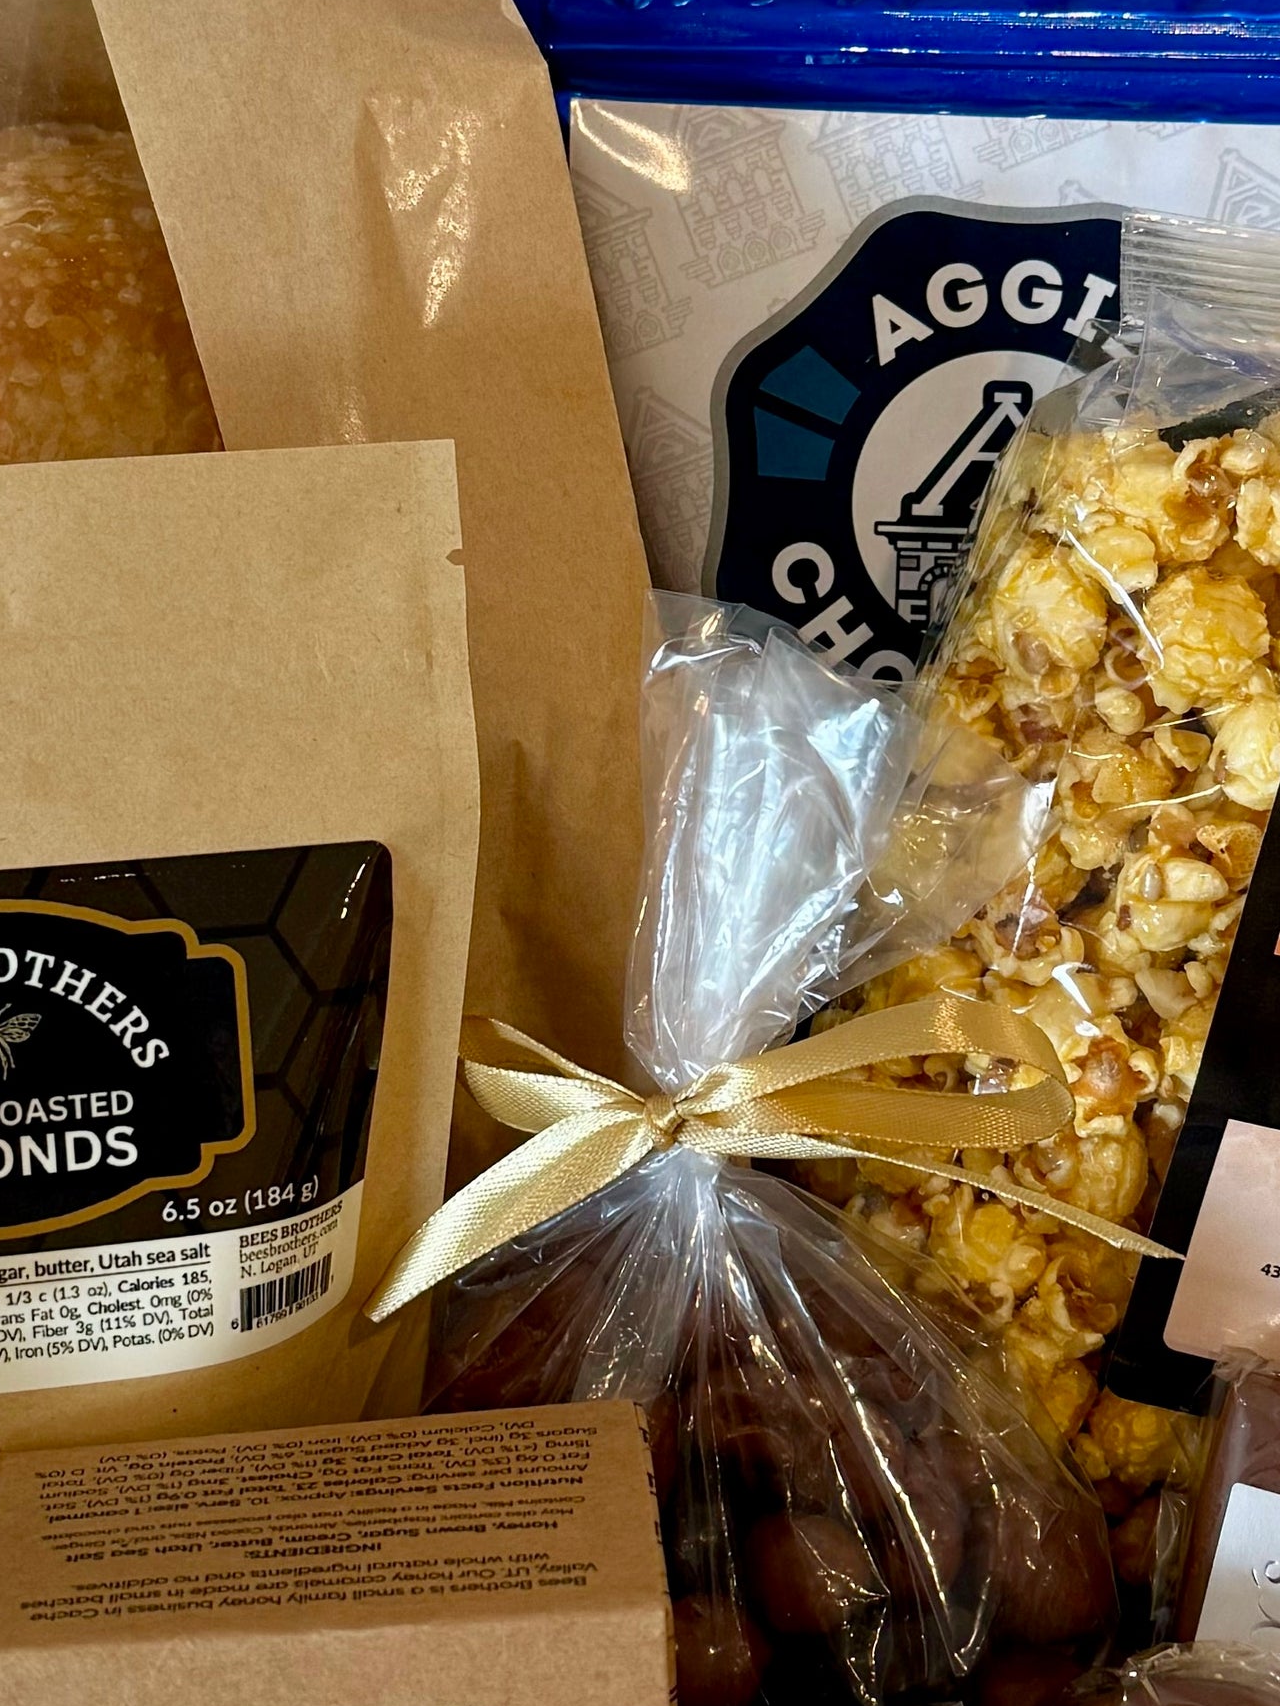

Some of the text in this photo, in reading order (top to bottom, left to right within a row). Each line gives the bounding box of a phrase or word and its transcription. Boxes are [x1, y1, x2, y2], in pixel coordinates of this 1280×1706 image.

[162, 1175, 319, 1222] 6.5 oz (184 g)
[239, 1201, 342, 1248] BEES BROTHERS
[239, 1219, 338, 1263] beesbrothers.com
[35, 1259, 94, 1276] butter,
[99, 1251, 142, 1269] Utah
[147, 1251, 175, 1264] sea
[181, 1243, 210, 1260] salt
[241, 1265, 256, 1279] N.
[303, 1242, 318, 1259] UT
[6, 1291, 32, 1306] 1/3
[39, 1292, 47, 1302] c
[54, 1286, 80, 1302] (1.3
[118, 1277, 174, 1293] Calories
[182, 1270, 212, 1285] 185,
[32, 1308, 54, 1322] Fat
[150, 1295, 181, 1308] 0mg
[187, 1288, 213, 1305] (0%
[33, 1324, 69, 1339] Fiber
[76, 1321, 93, 1336] 3g
[101, 1315, 136, 1333] (11%
[179, 1304, 213, 1320] Total
[15, 1346, 43, 1360] Iron
[47, 1340, 74, 1357] (5%
[113, 1335, 155, 1348] Potas.
[158, 1328, 184, 1344] (0%
[188, 1322, 214, 1338] DV)
[426, 1524, 486, 1535] Brown
[110, 1547, 150, 1557] Sea
[154, 1543, 202, 1554] Utah
[244, 1543, 382, 1559] INGREDIENTS:
[66, 1552, 104, 1562] Salt
[444, 1556, 502, 1567] whole
[508, 1553, 550, 1563] with
[250, 1563, 362, 1580] ingredients
[367, 1559, 438, 1572] natural
[173, 1575, 199, 1583] no
[205, 1571, 245, 1582] and
[392, 1571, 453, 1583] honey
[458, 1569, 495, 1580] Our
[255, 1582, 288, 1591] are
[294, 1575, 386, 1589] caramels
[109, 1590, 161, 1603] small
[167, 1589, 184, 1598] in
[190, 1584, 249, 1597] made
[21, 1595, 103, 1610] batches
[30, 1576, 586, 1621] Bees Brothers is a small family honey business in Cache
